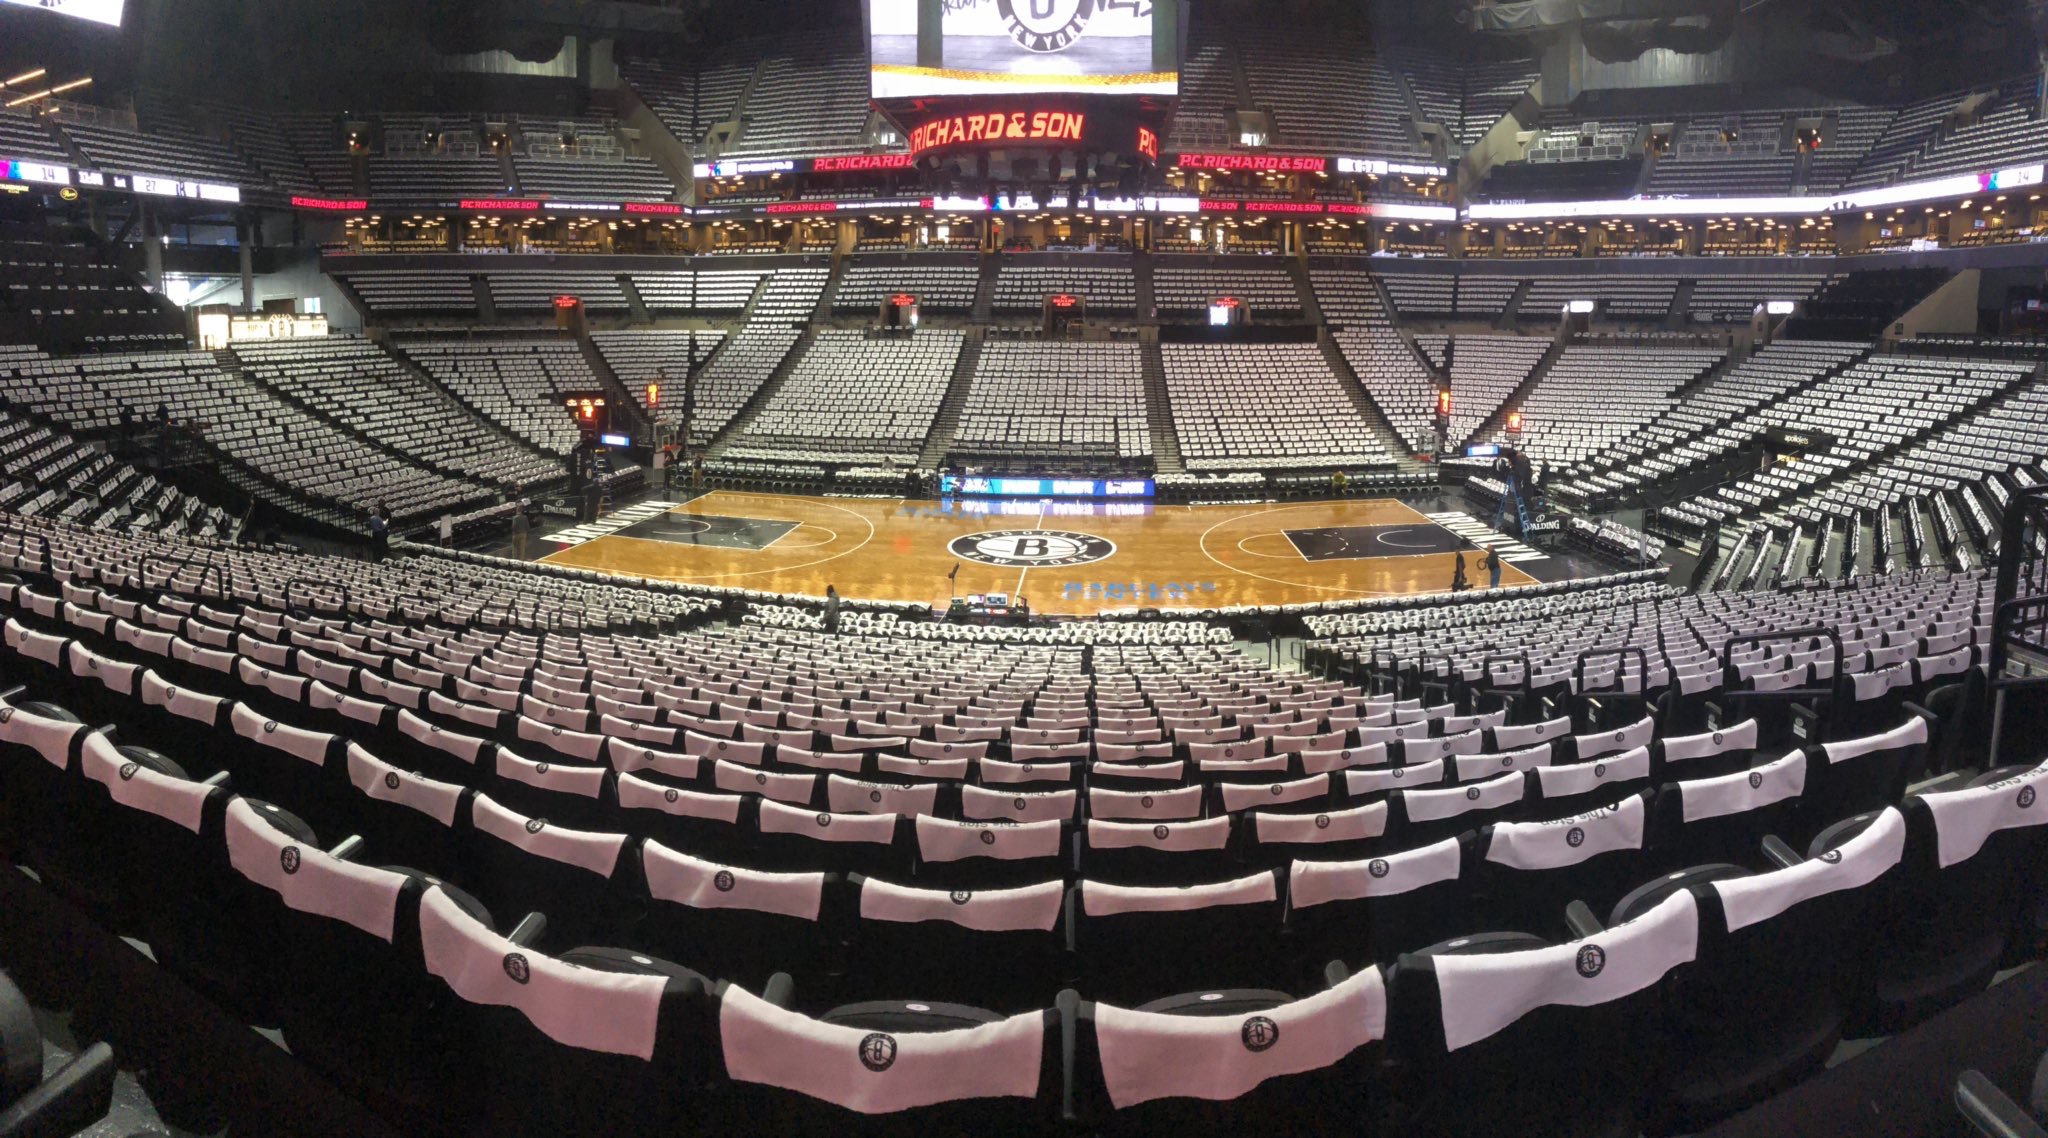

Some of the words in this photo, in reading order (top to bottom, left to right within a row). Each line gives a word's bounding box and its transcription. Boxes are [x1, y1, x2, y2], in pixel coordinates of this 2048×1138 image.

[1002, 15, 1037, 48] NEW
[1043, 13, 1089, 50] YORK
[914, 114, 1005, 152] RICHARD
[1006, 113, 1026, 138] &
[1030, 112, 1083, 139] SON
[836, 155, 906, 169] RICHARD
[1203, 155, 1278, 169] RICHARD
[1279, 157, 1291, 169] &
[1292, 158, 1326, 170] SON
[41, 167, 55, 180] 14
[346, 200, 367, 209] SON
[474, 201, 513, 209] RICHARD
[520, 201, 539, 209] SON
[820, 202, 836, 211] SON
[1221, 202, 1238, 210] SON
[1259, 203, 1297, 211] RICHARD
[1305, 204, 1323, 212] SON
[543, 504, 577, 517] SPALDING
[967, 530, 1102, 543] BROOKLYN
[1424, 512, 1551, 562] BROOKLYN
[1013, 538, 1050, 557] B
[963, 551, 1013, 564] NEW
[1030, 553, 1098, 566] YORK
